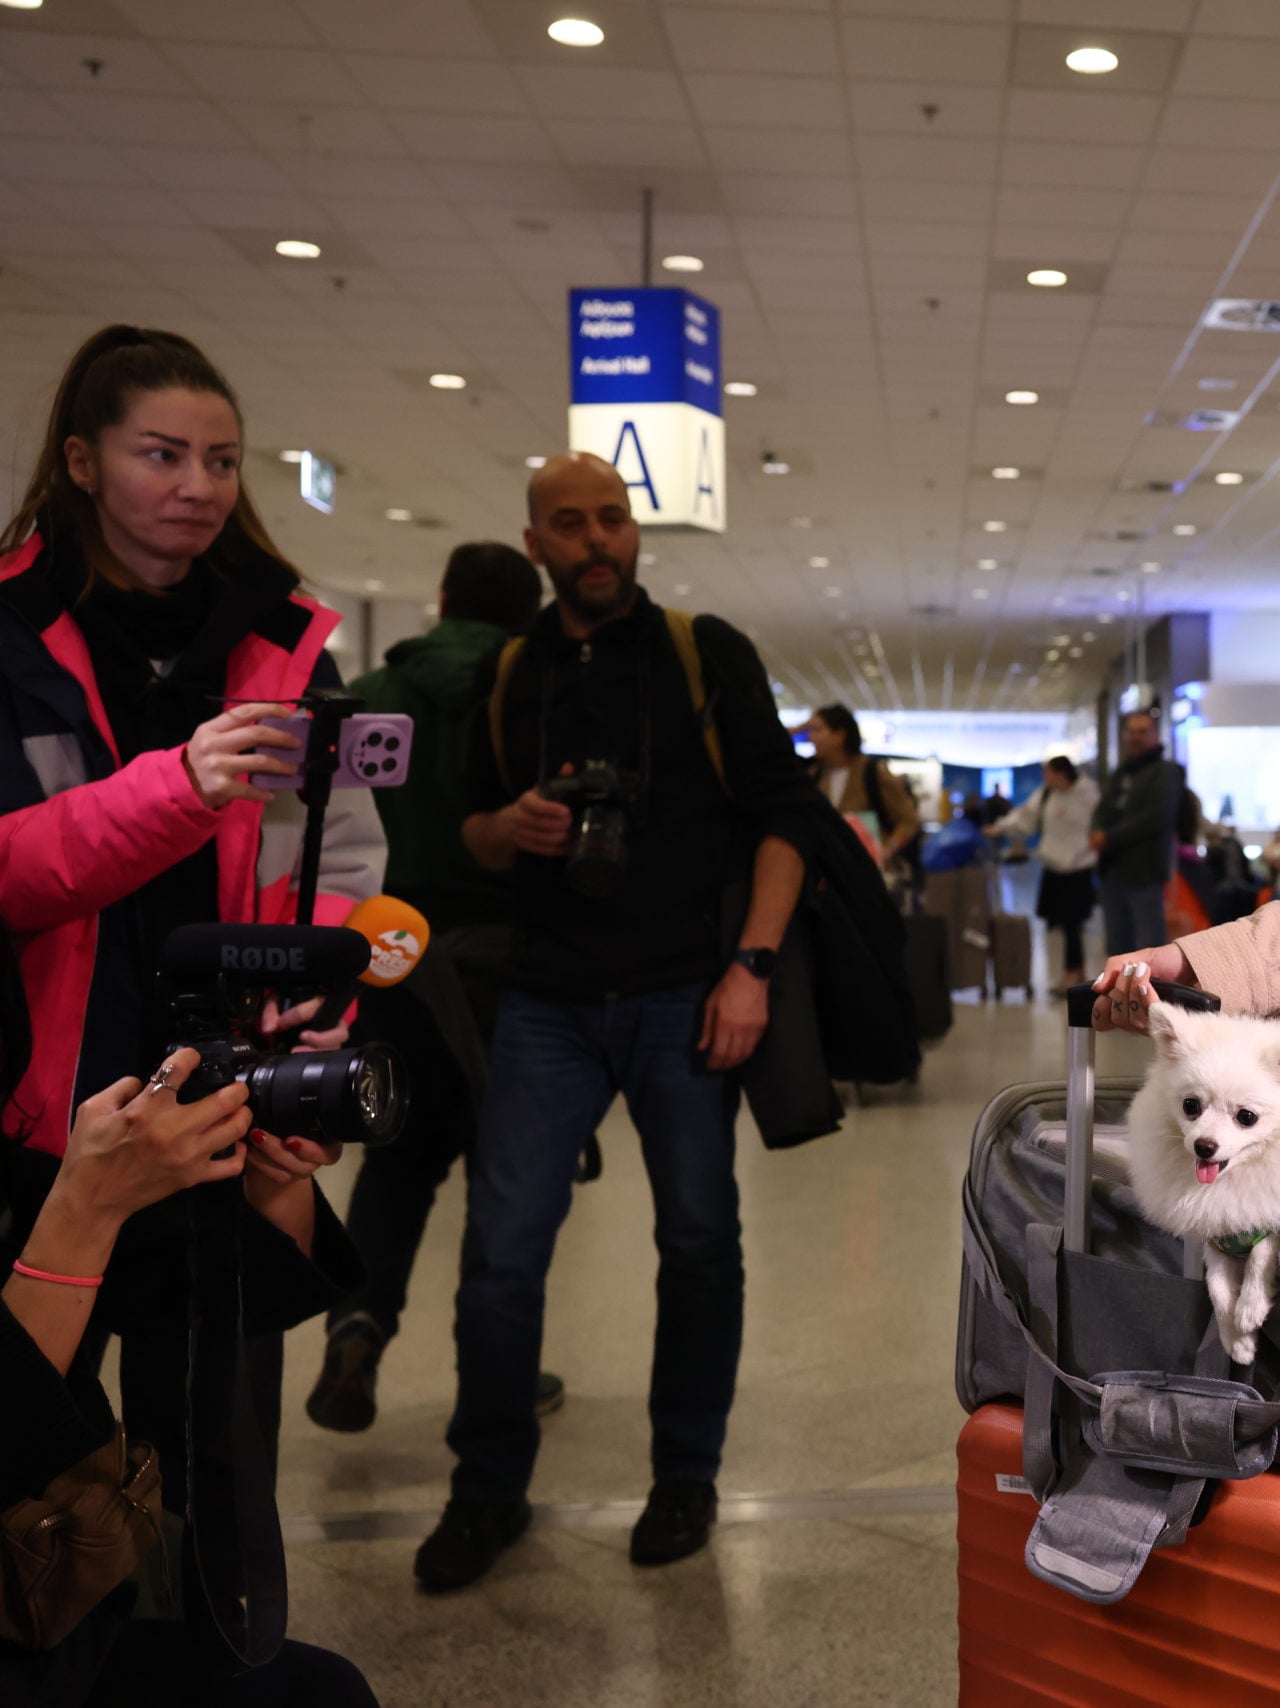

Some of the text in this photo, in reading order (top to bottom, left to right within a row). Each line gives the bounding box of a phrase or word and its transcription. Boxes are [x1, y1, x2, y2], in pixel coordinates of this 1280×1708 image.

[613, 421, 660, 511] A
[220, 944, 306, 971] RØDE
[232, 1045, 251, 1053] SONY
